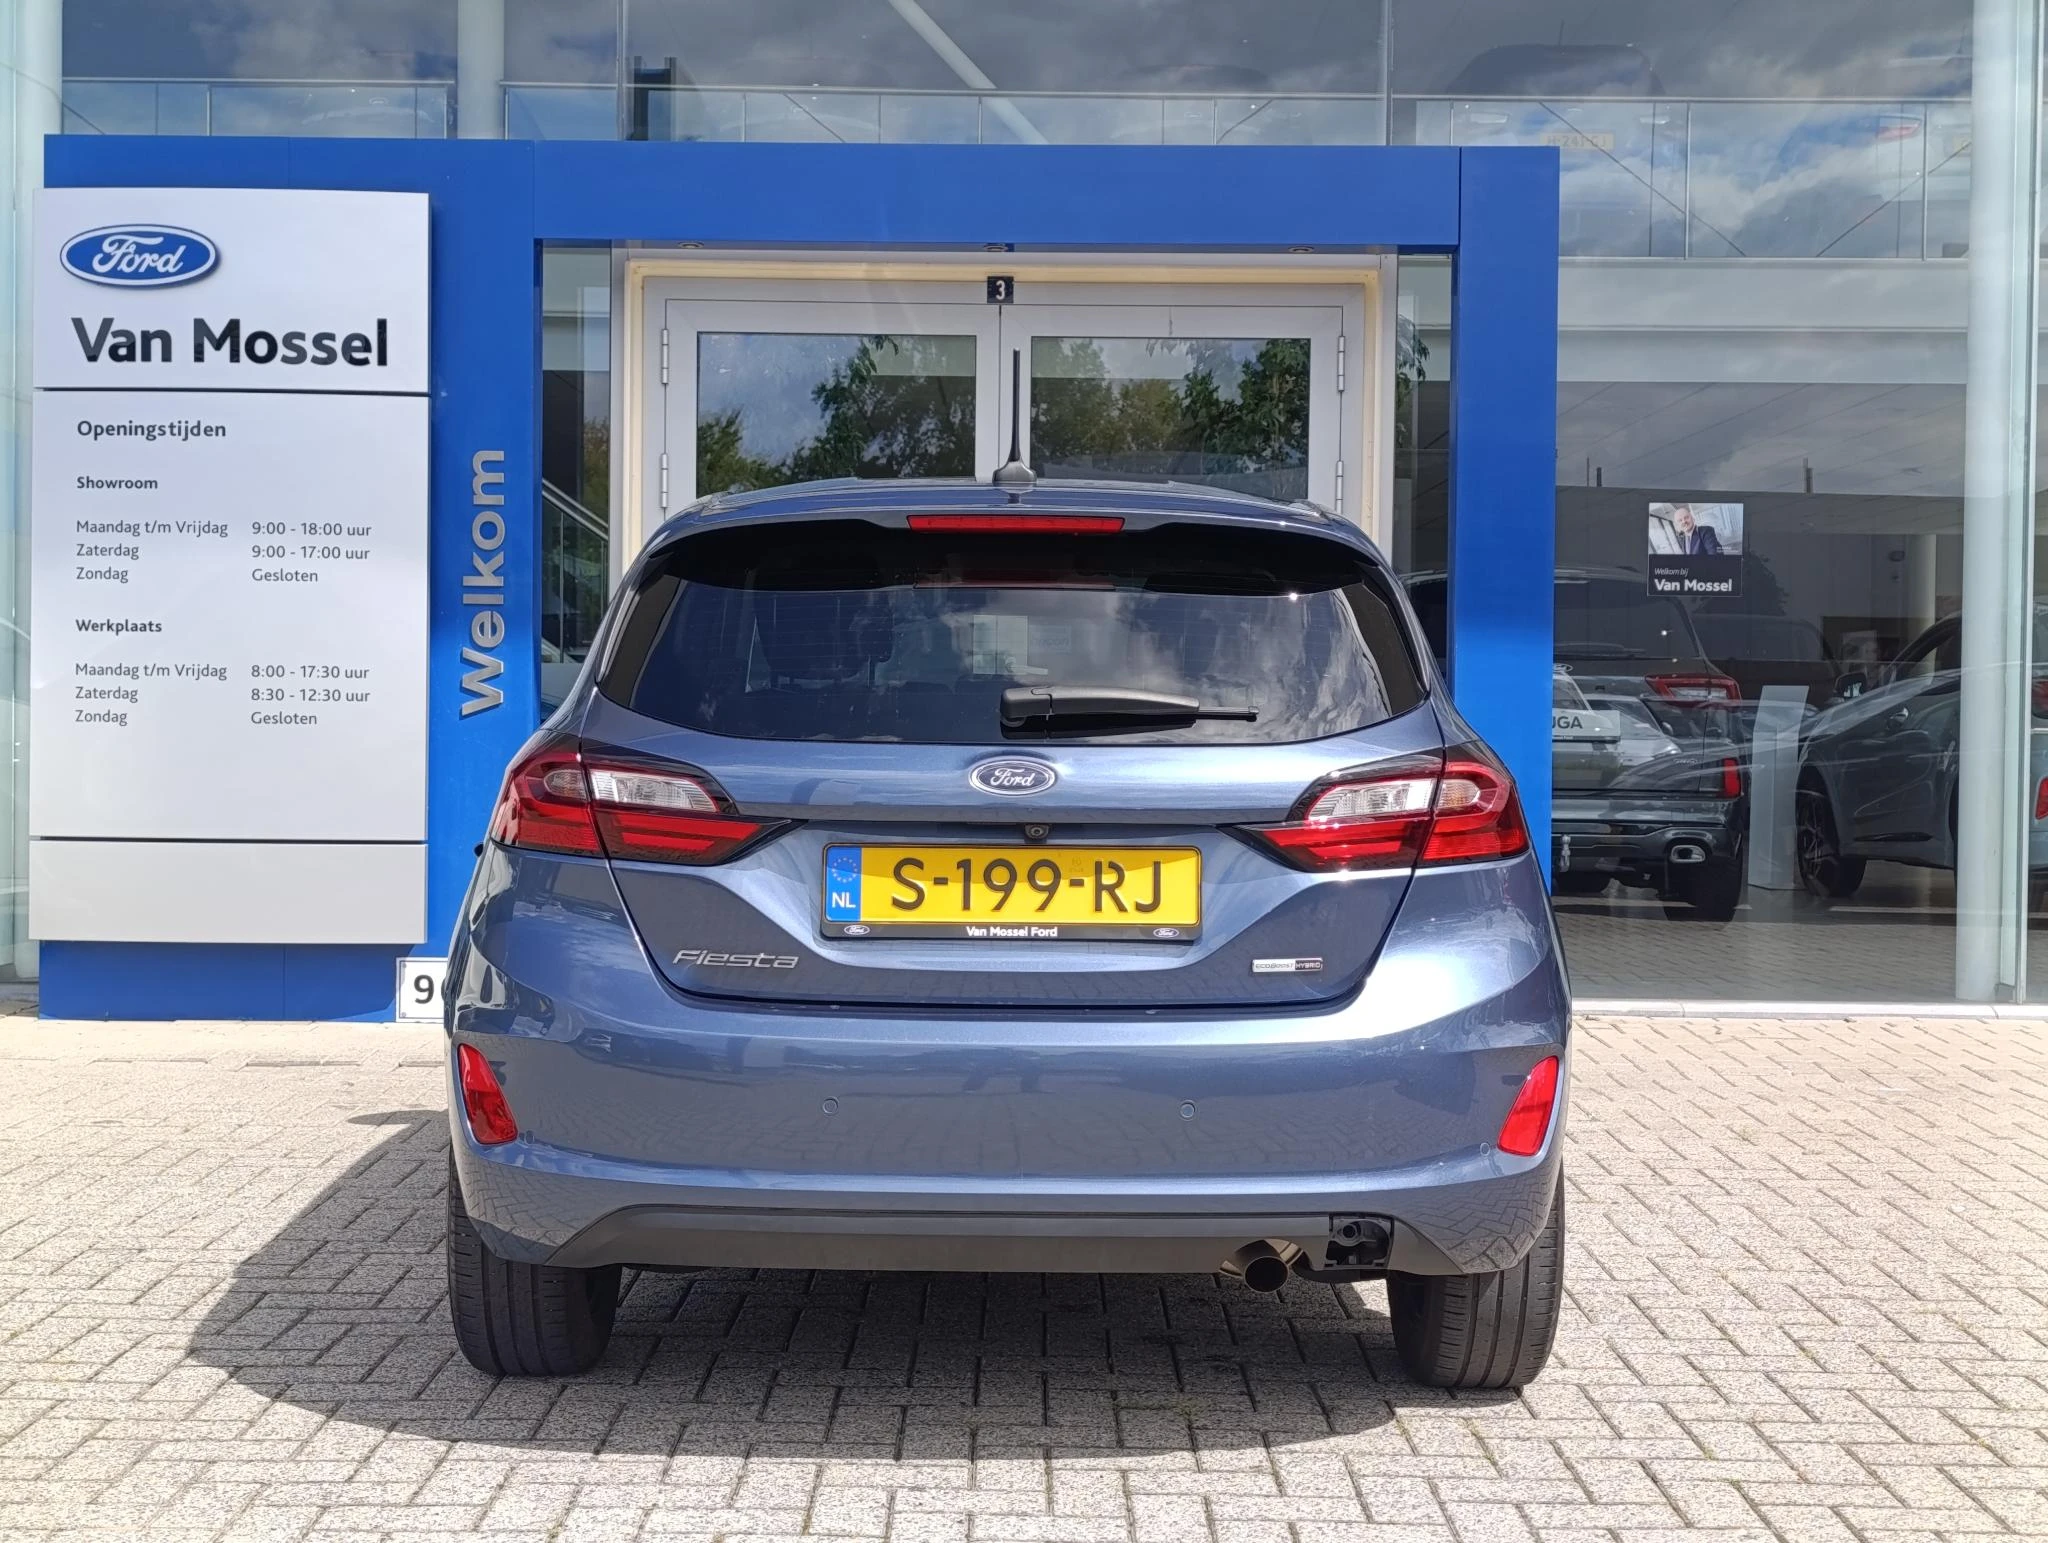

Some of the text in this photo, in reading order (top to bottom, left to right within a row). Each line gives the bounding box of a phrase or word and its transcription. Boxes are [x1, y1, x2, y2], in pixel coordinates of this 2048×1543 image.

[92, 234, 187, 274] Ford
[996, 280, 1005, 300] 3
[71, 317, 388, 367] Van Mossel
[77, 420, 227, 441] Openingstijden
[77, 475, 158, 490] Showroom
[76, 519, 140, 538] Maandag
[144, 519, 172, 534] t/m
[175, 520, 229, 538] Vrijdag
[251, 522, 286, 535] 9:00
[300, 523, 343, 536] 18:00
[346, 526, 372, 537] uur
[76, 542, 140, 561] Zaterdag
[251, 545, 286, 558] 9:00
[300, 546, 341, 559] 17:00
[345, 549, 371, 560] uur
[76, 566, 319, 584] Zondag Gesloten
[1654, 568, 1679, 576] Welkom
[461, 450, 506, 716] Welkom
[1654, 578, 1733, 592] Van Mossel
[76, 619, 163, 636] Werkplaats
[75, 662, 140, 681] Maandag
[143, 663, 170, 677] t/m
[174, 664, 228, 681] Vrijdag
[251, 665, 286, 678] 8:00
[300, 666, 341, 679] 17:30
[344, 668, 370, 679] uur
[75, 686, 139, 704] Zaterdag
[250, 688, 286, 701] 8:30
[300, 689, 342, 702] 12:30
[345, 692, 371, 702] uur
[75, 709, 318, 727] Zondag Gesloten
[891, 857, 1162, 914] S-199-RJ
[831, 892, 856, 908] NL
[966, 926, 1058, 937] Van Mossel Ford
[672, 949, 800, 969] Fiesta
[1295, 961, 1321, 969] HYBRID
[413, 974, 446, 1005] 9
